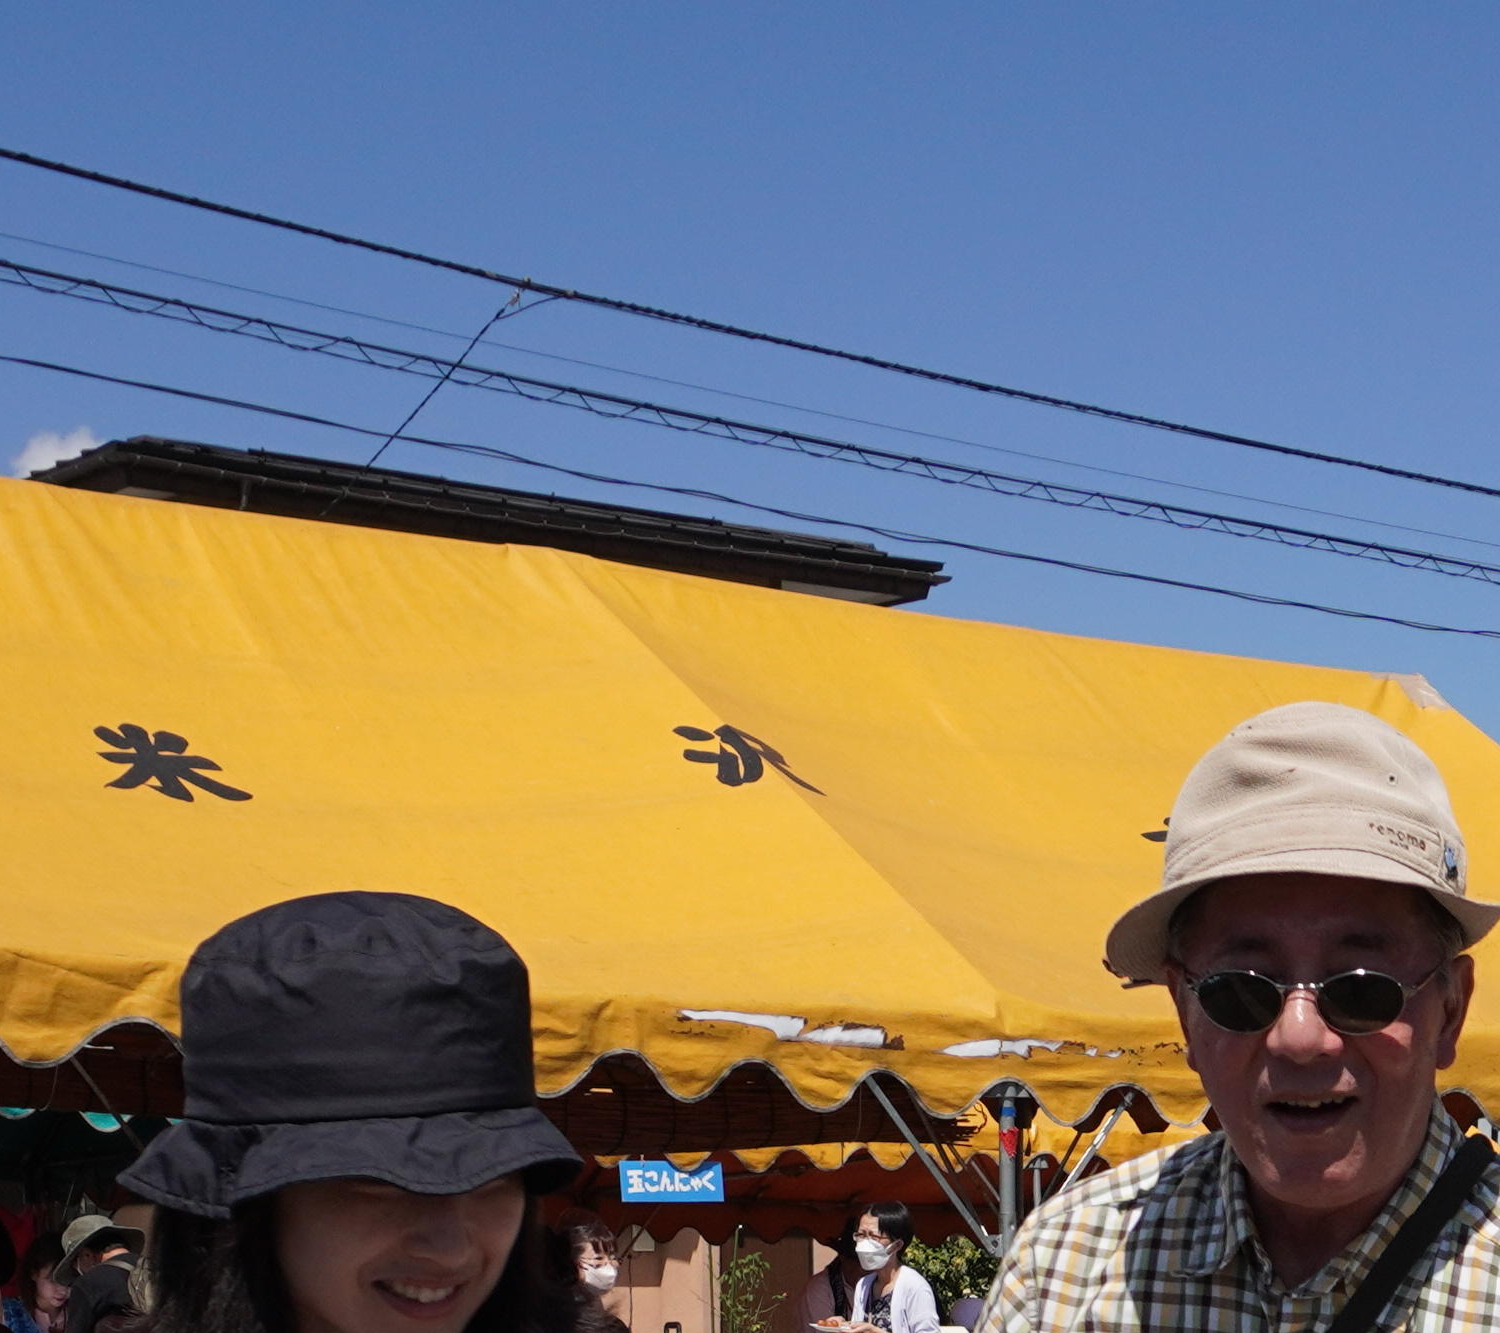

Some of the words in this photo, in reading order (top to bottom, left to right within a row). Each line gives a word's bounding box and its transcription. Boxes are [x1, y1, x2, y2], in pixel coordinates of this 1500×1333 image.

[626, 1168, 717, 1194] 玉こんにゃく
